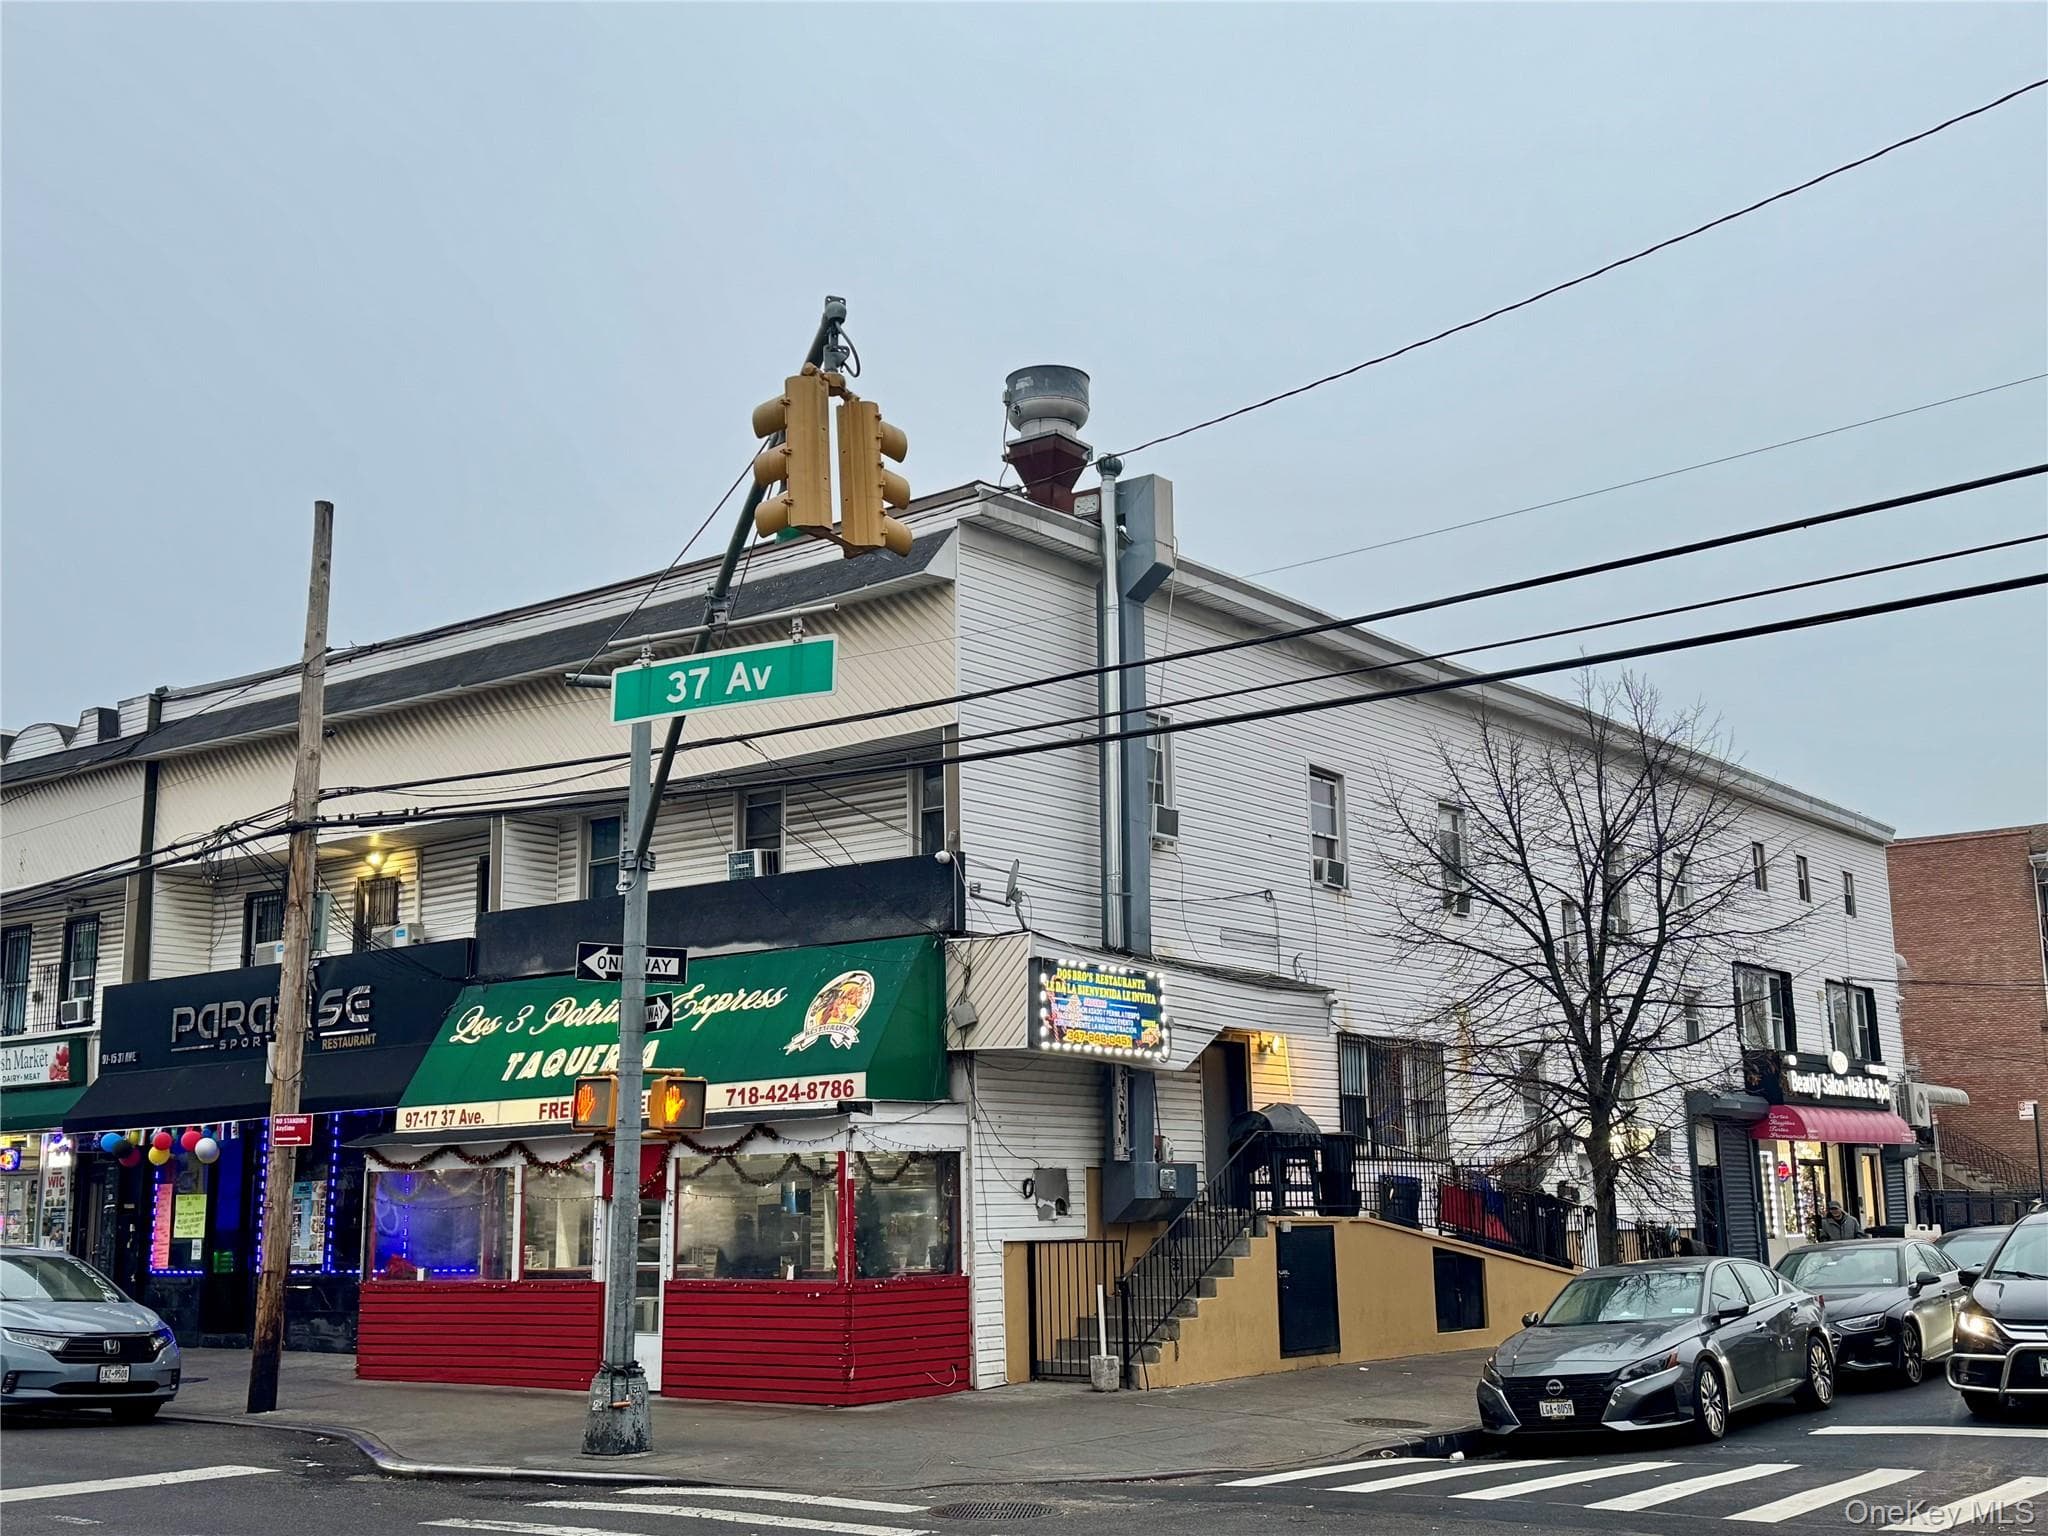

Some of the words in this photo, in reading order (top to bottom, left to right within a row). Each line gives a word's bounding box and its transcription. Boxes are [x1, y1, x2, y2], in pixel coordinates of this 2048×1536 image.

[666, 667, 711, 704] 37
[725, 661, 772, 695] Av
[597, 956, 624, 971] ON
[645, 958, 672, 973] AY
[1057, 968, 1072, 981] DOS
[1072, 971, 1094, 983] BRO'S
[1096, 974, 1146, 989] RESTAURANTE
[1067, 983, 1077, 994] LA
[1078, 985, 1121, 1000] BIENVENIDA
[1122, 990, 1131, 1001] LE
[1132, 991, 1157, 1005] INVITA
[171, 985, 371, 1043] PARAISE
[449, 1005, 502, 1044] Los
[505, 1005, 535, 1033] 3
[673, 983, 788, 1031] Express
[647, 1004, 665, 1020] WAY
[322, 1033, 377, 1050] RESTAURANT
[14, 1047, 48, 1070] Market
[501, 1039, 660, 1081] TAQUERA
[24, 1072, 41, 1080] MEAT
[726, 1079, 855, 1106] 718-424-8786
[1789, 1070, 1821, 1099] Beauty
[1822, 1073, 1845, 1096] Salon
[1847, 1076, 1868, 1098] Nails
[1875, 1079, 1890, 1104] Spa
[405, 1112, 437, 1128] 97-17
[440, 1109, 455, 1126] 37
[458, 1107, 485, 1124] Ave.
[539, 1101, 573, 1120] FRE
[48, 1176, 66, 1189] WIC
